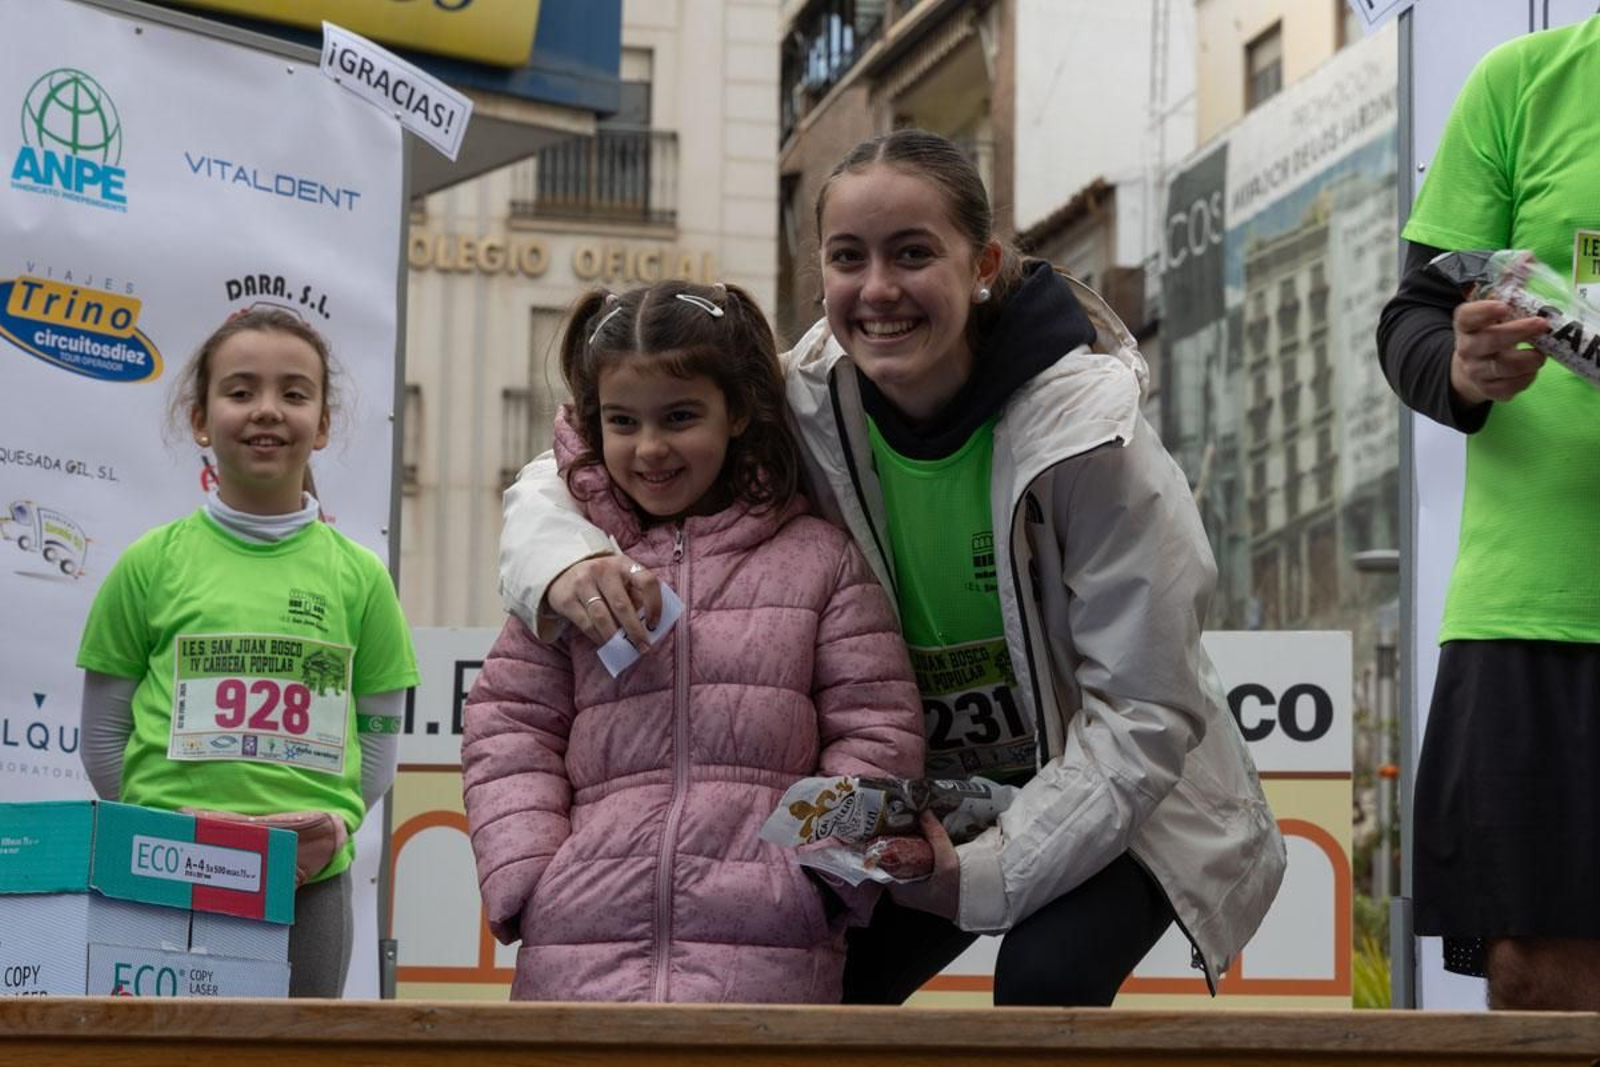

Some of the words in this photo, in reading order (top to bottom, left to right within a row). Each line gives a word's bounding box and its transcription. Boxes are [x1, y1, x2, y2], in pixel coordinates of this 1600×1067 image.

[327, 42, 455, 135] ¡GRACIAS!
[11, 145, 128, 204] ANPE
[185, 152, 361, 212] VITALDENT
[27, 261, 134, 295] VIAJES
[20, 280, 133, 331] Trino
[34, 329, 146, 366] circuitosdiez
[0, 448, 61, 471] QUESADA
[203, 656, 246, 673] CARRERA
[250, 656, 294, 673] POPULAR
[211, 639, 232, 655] SAN
[236, 639, 267, 655] JUAN
[270, 639, 303, 658] BOSCO
[949, 647, 989, 669] BOSCO
[214, 678, 311, 736] 928
[1226, 682, 1334, 743] CO
[137, 842, 180, 874] ECO
[184, 856, 205, 873] A-4
[4, 964, 41, 988] COPY
[114, 962, 178, 997] ECO
[189, 969, 214, 984] COPY
[189, 983, 219, 997] LASER
